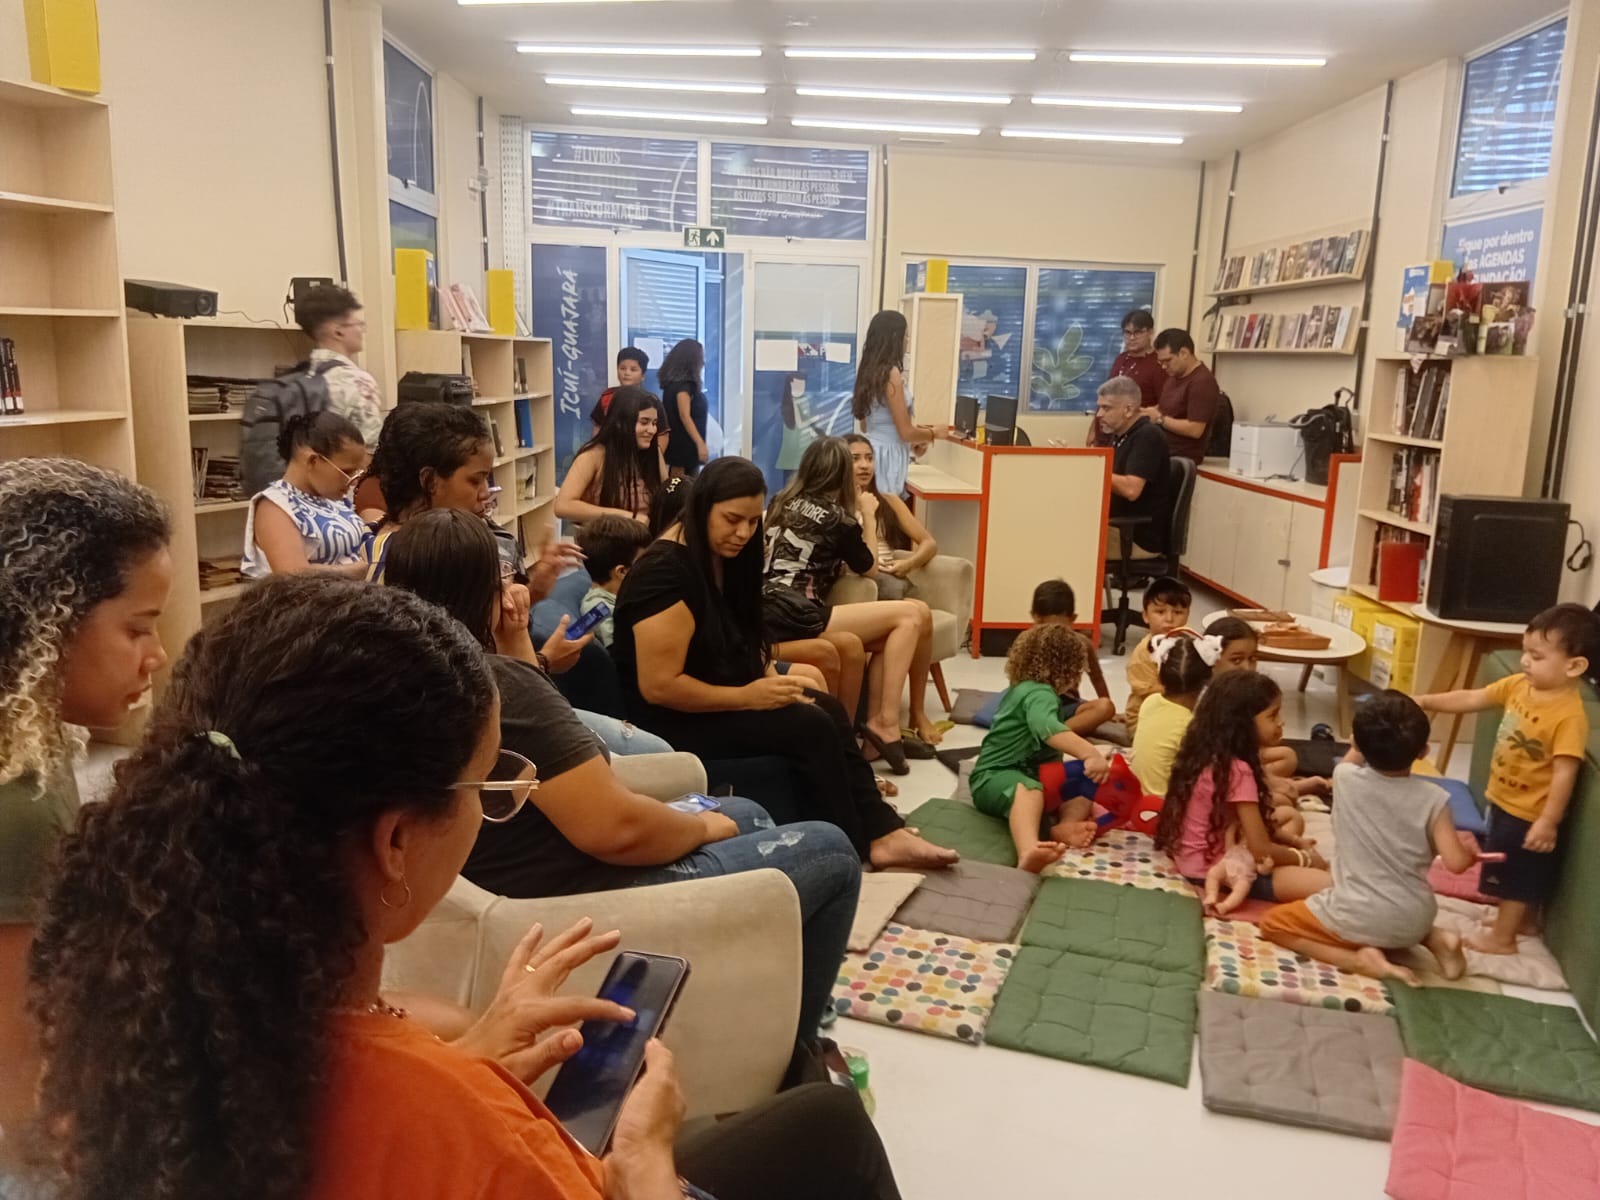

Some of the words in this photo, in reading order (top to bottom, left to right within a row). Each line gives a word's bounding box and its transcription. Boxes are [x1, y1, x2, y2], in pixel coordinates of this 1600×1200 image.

[573, 147, 621, 165] #LIVROS
[546, 199, 649, 223] #TRANSFORMAÇÃO
[1482, 234, 1500, 254] por
[1500, 229, 1535, 247] dentro
[1479, 247, 1526, 269] AGENDAS
